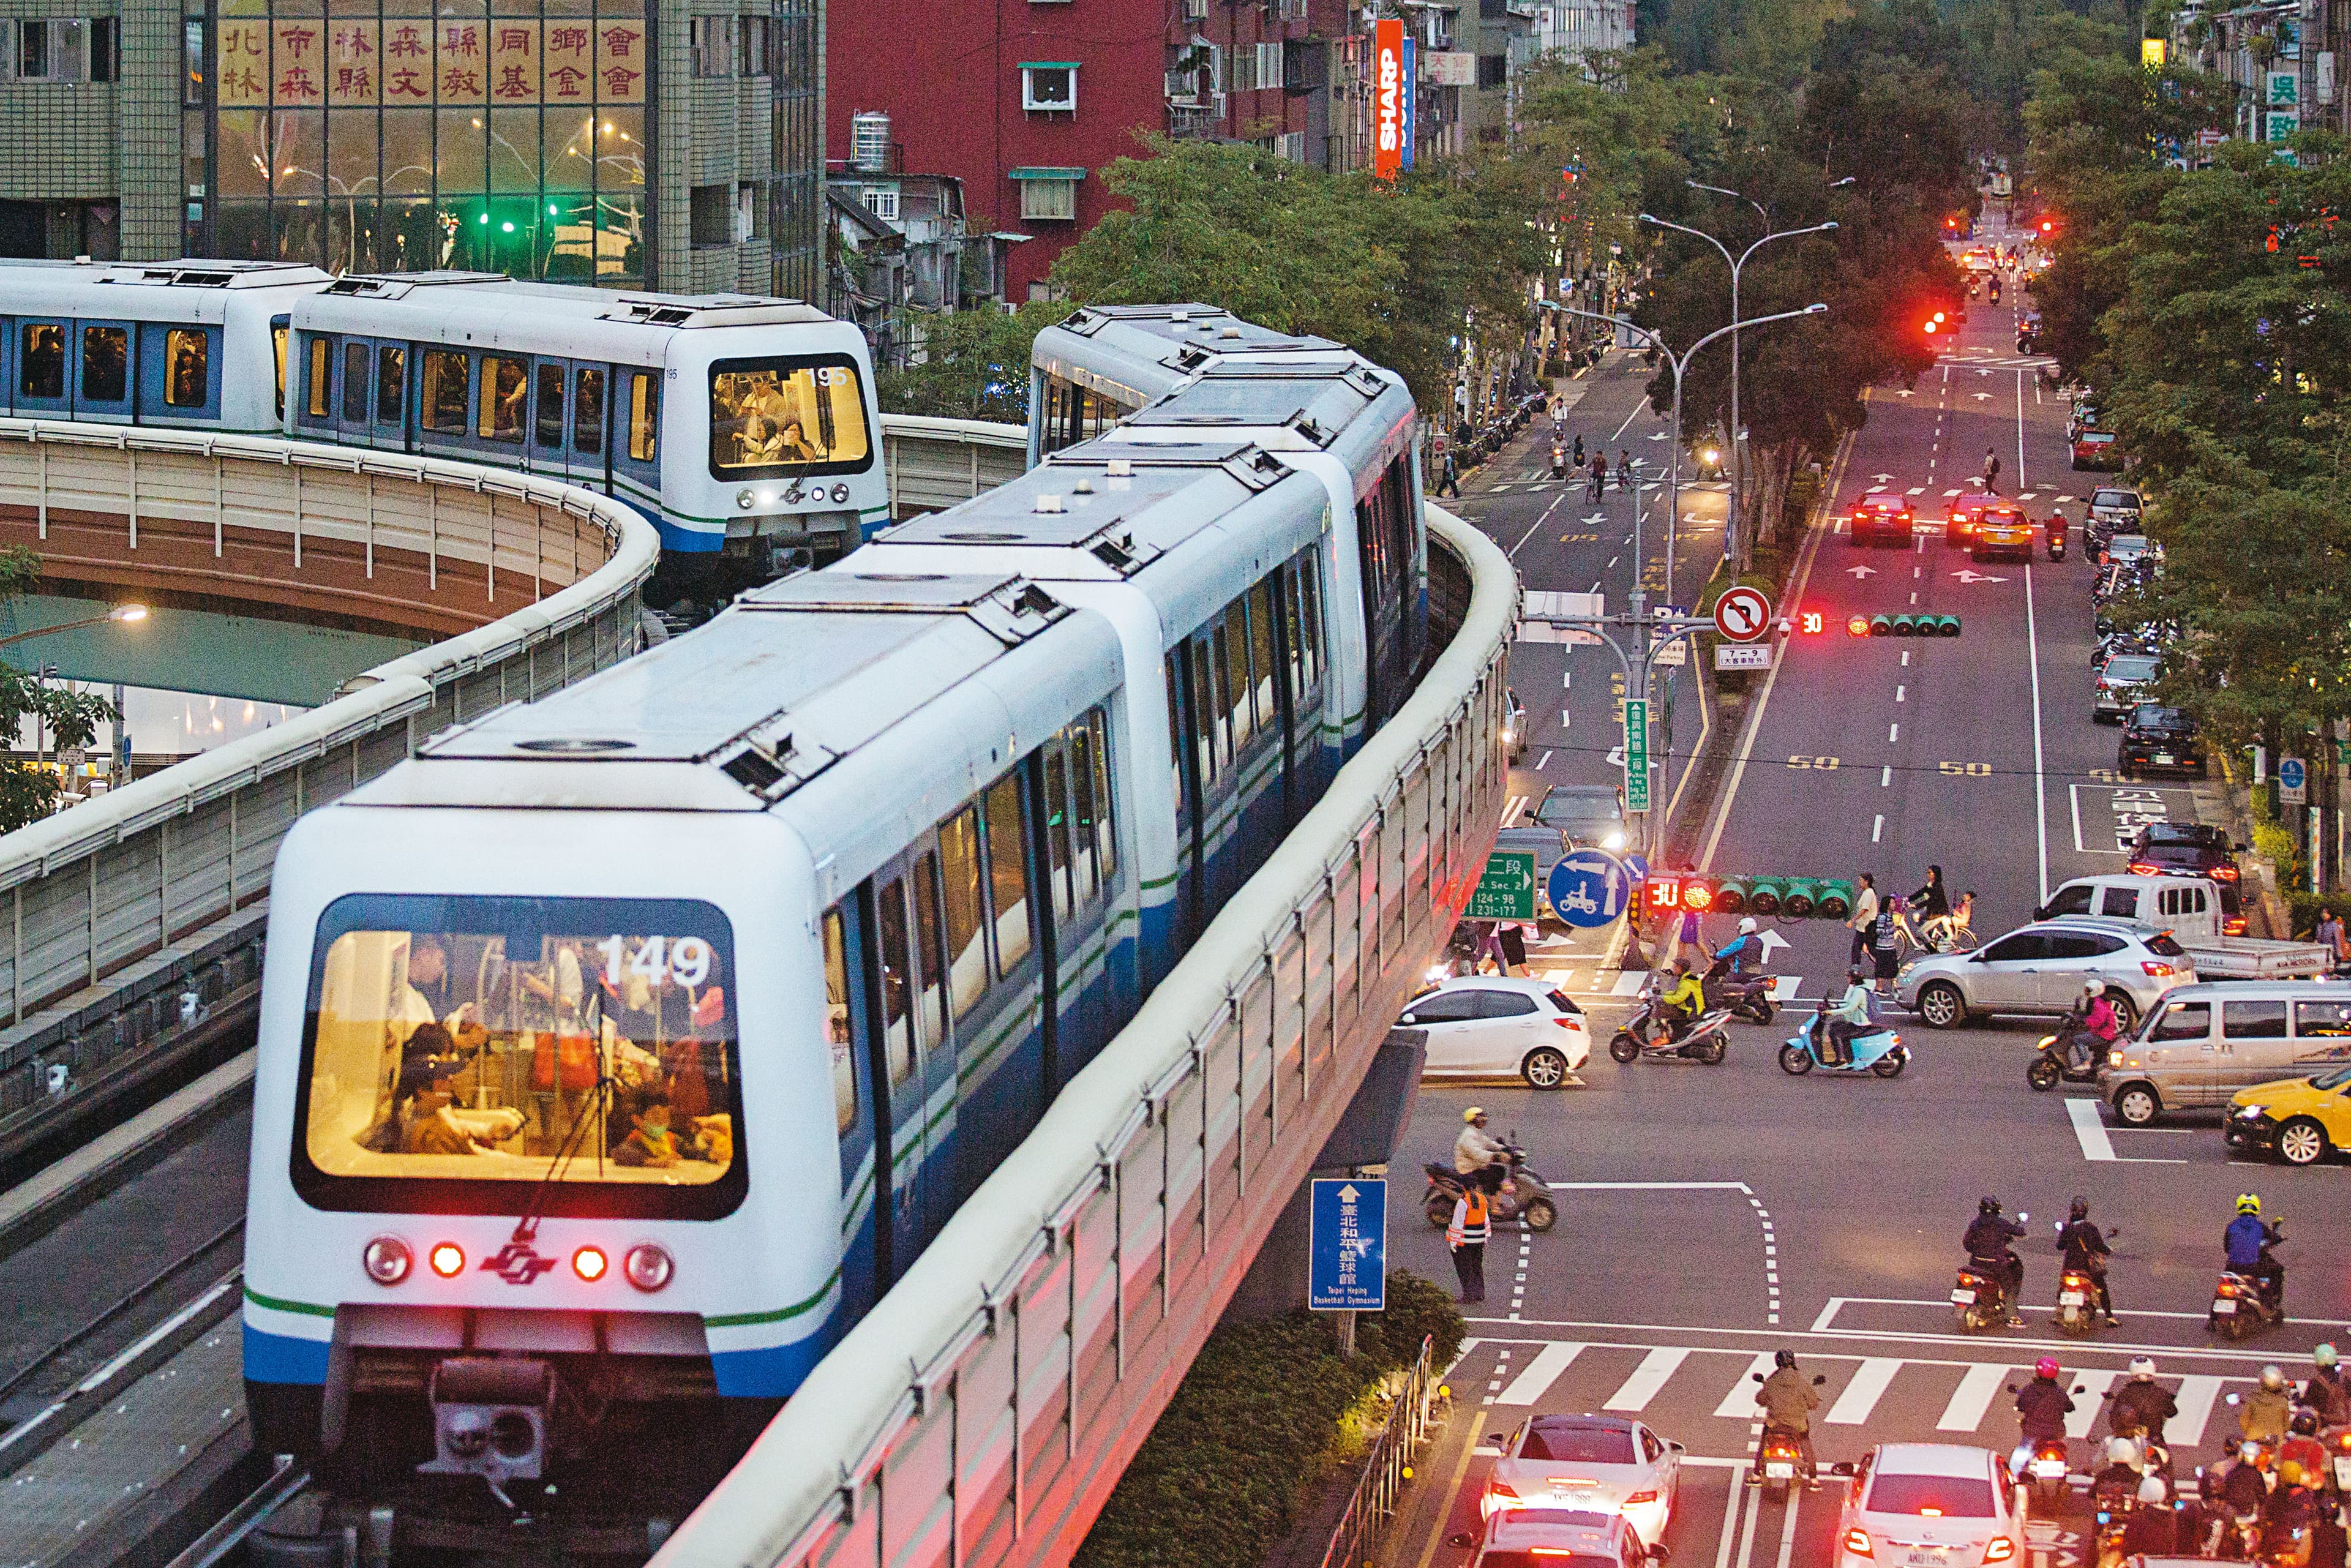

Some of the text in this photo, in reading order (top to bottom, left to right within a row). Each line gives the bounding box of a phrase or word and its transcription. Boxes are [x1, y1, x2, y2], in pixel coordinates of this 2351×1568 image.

[1379, 48, 1398, 151] SHARP
[666, 369, 678, 380] 195
[806, 367, 847, 388] 195
[1803, 613, 1822, 633] 30
[1787, 755, 1840, 770] 50
[1940, 761, 1992, 776] 50
[1515, 881, 1522, 890] 2
[596, 934, 711, 987] 149
[1339, 1204, 1358, 1285] 臺北和平籃球館
[1327, 1286, 1367, 1296] Taipei Heping
[1313, 1296, 1381, 1307] Basketball Gymnasium
